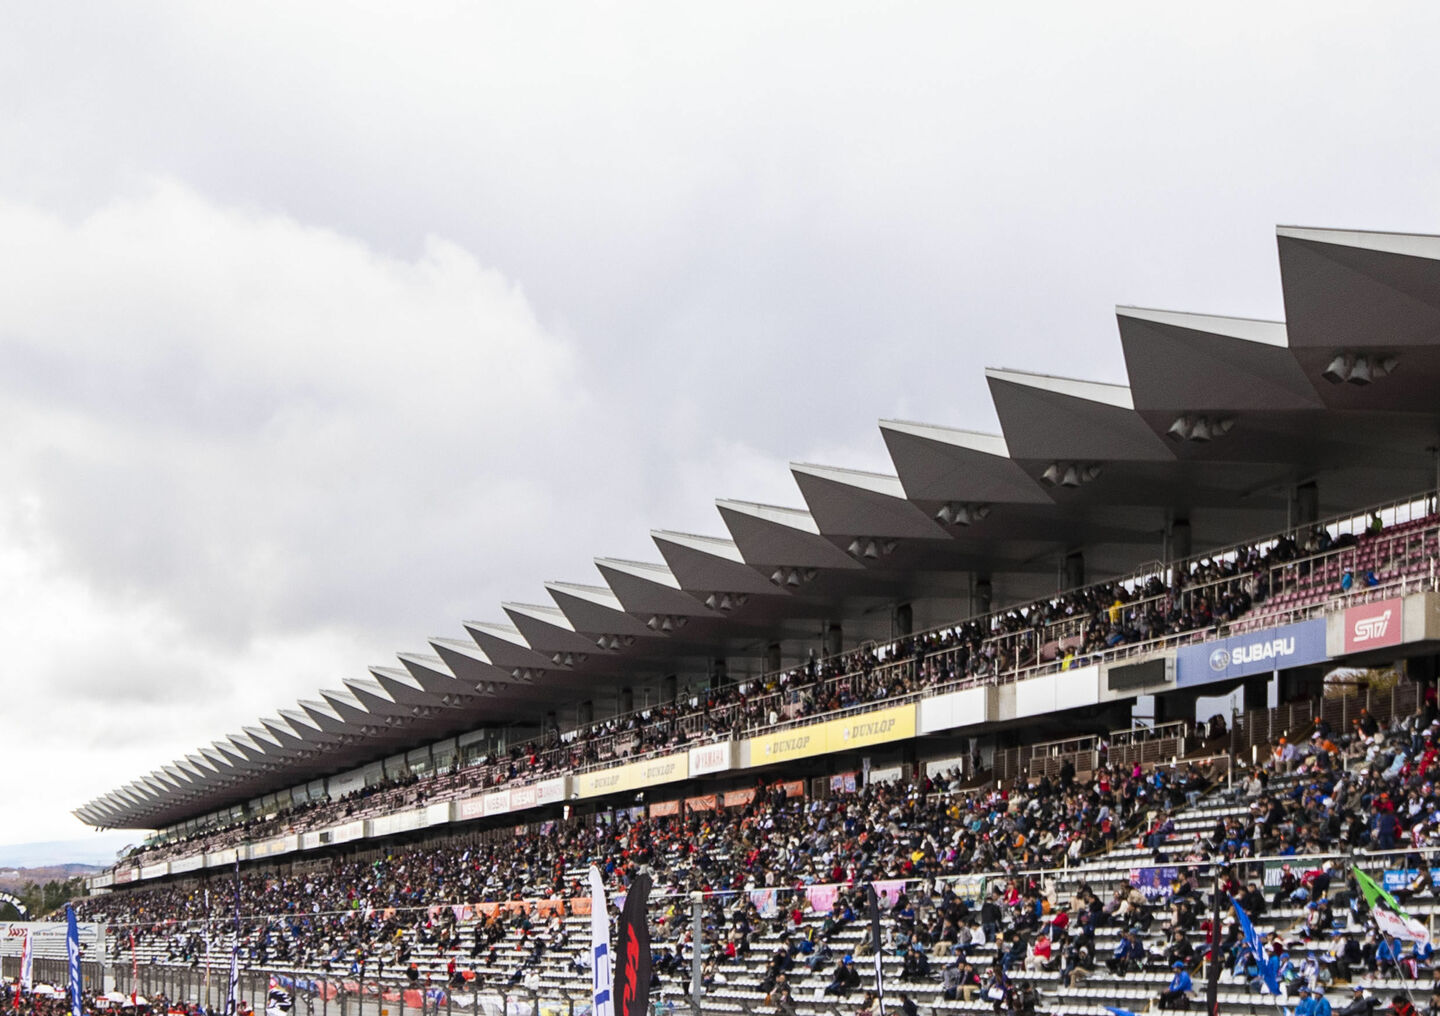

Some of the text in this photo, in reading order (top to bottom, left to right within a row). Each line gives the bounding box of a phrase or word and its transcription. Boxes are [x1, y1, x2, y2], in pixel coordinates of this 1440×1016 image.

[1232, 636, 1295, 666] SUBARU
[852, 718, 895, 739] DUNLOP
[773, 736, 810, 754] DUNLOP
[646, 763, 676, 778] DUNLOP
[594, 775, 620, 789] DUNLOP
